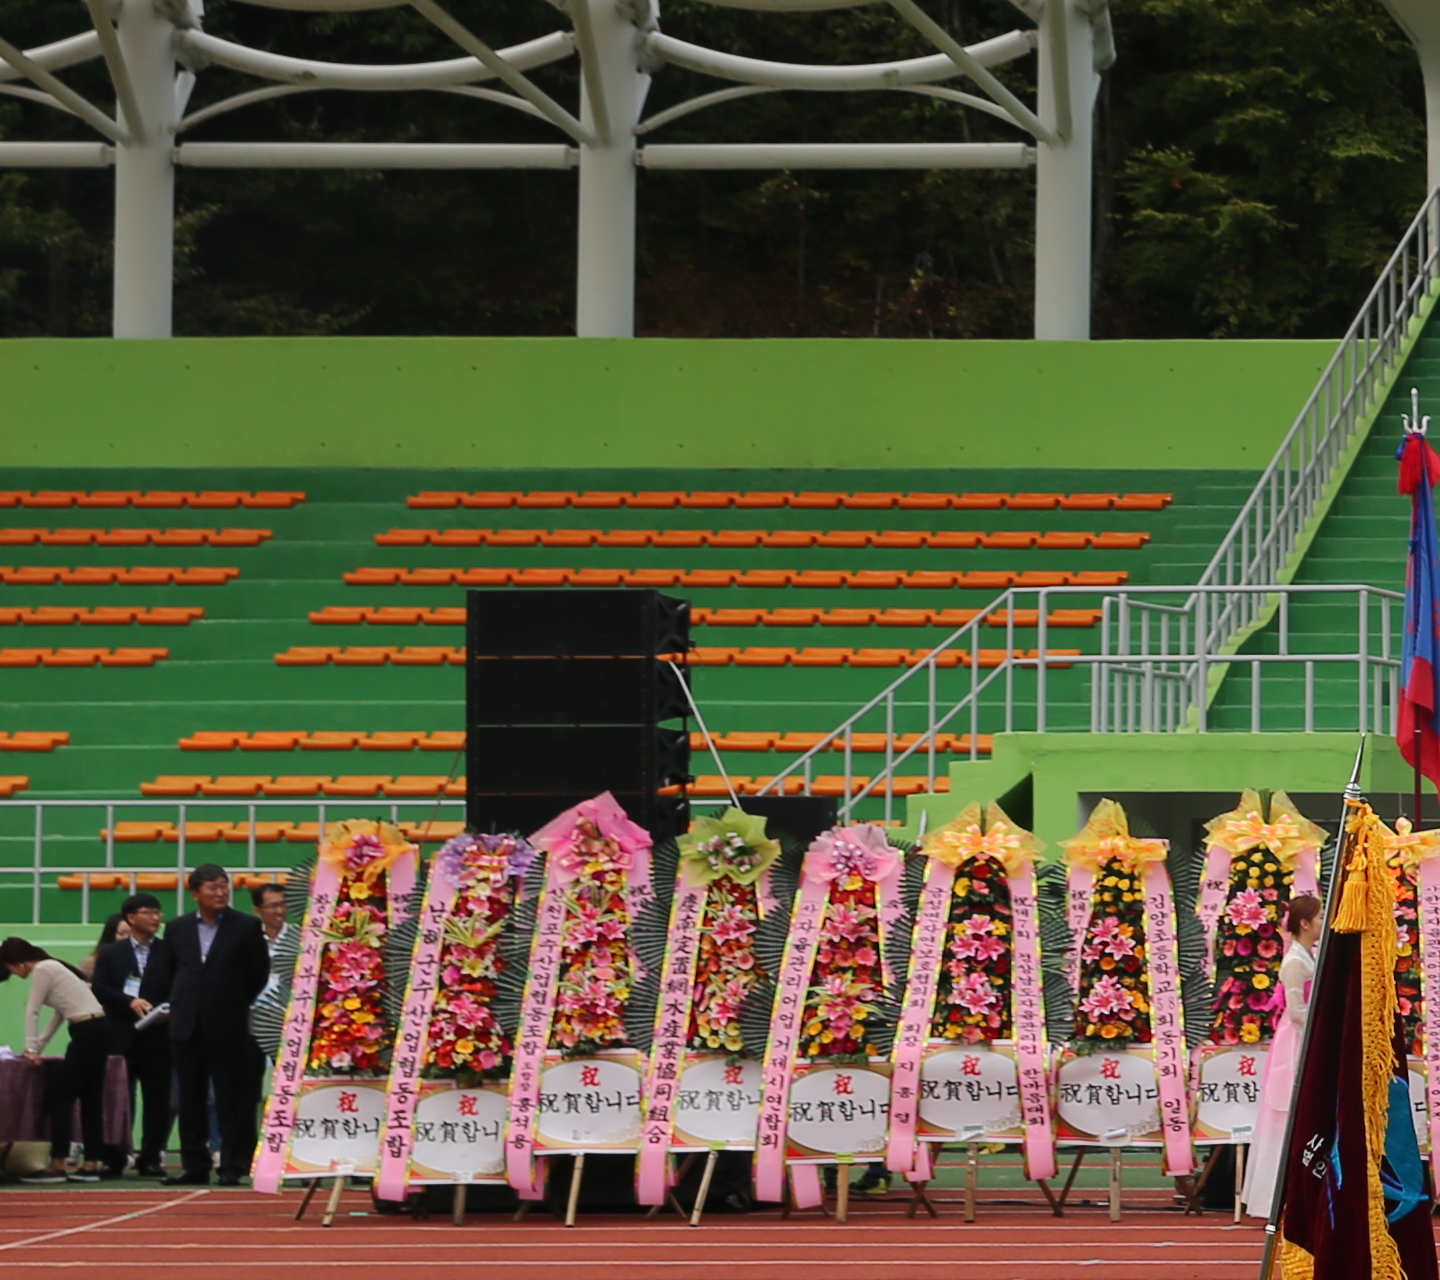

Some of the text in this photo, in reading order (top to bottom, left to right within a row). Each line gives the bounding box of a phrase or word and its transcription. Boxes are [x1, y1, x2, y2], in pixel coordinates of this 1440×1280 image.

[722, 1065, 744, 1086] 祝
[960, 1054, 982, 1076] 祝
[1100, 1057, 1122, 1079] 祝
[1236, 1055, 1257, 1077] 祝
[577, 1066, 601, 1088] 祝
[832, 1073, 854, 1095] 祝
[336, 1091, 359, 1114] 祝
[458, 1095, 479, 1118] 祝
[296, 1117, 380, 1141] 祝賀합니
[416, 1121, 500, 1145] 祝賀합니
